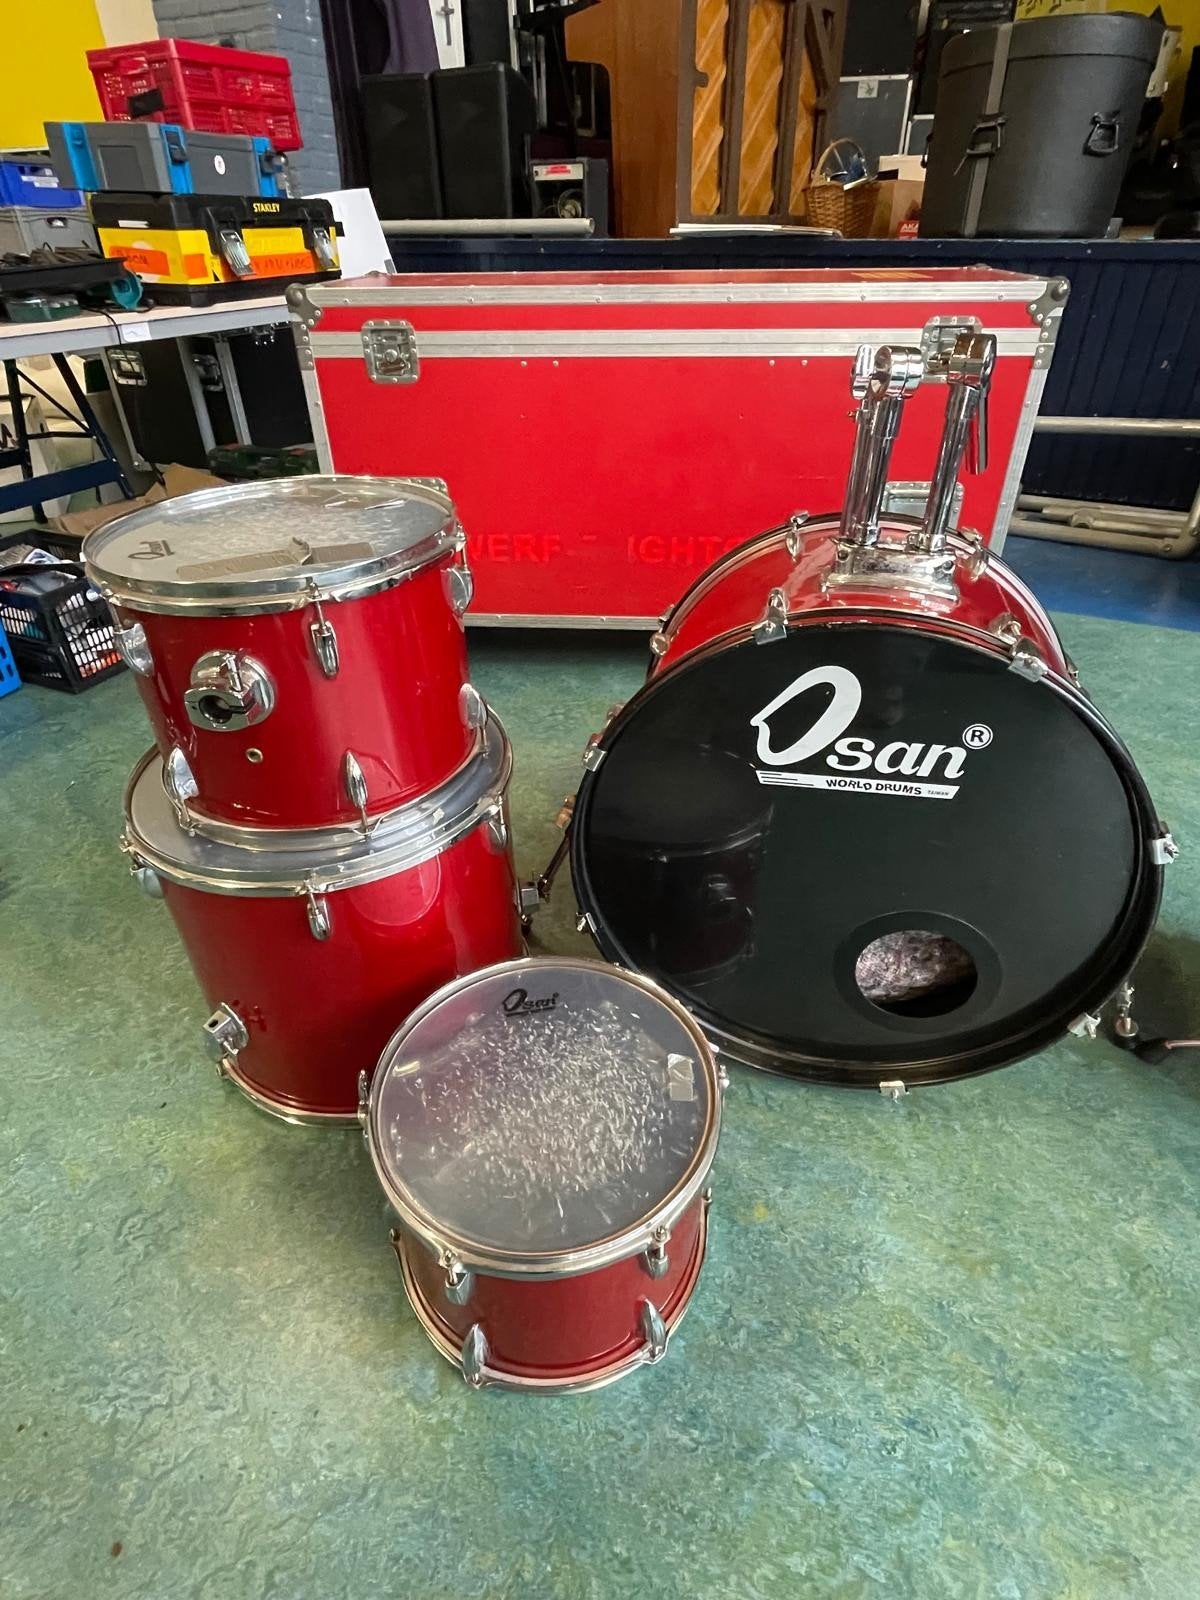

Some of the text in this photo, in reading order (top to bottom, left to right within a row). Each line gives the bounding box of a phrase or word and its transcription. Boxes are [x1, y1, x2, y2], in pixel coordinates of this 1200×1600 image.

[252, 202, 280, 213] STANLEY
[825, 779, 873, 791] WORLD
[875, 782, 922, 795] DRUMS
